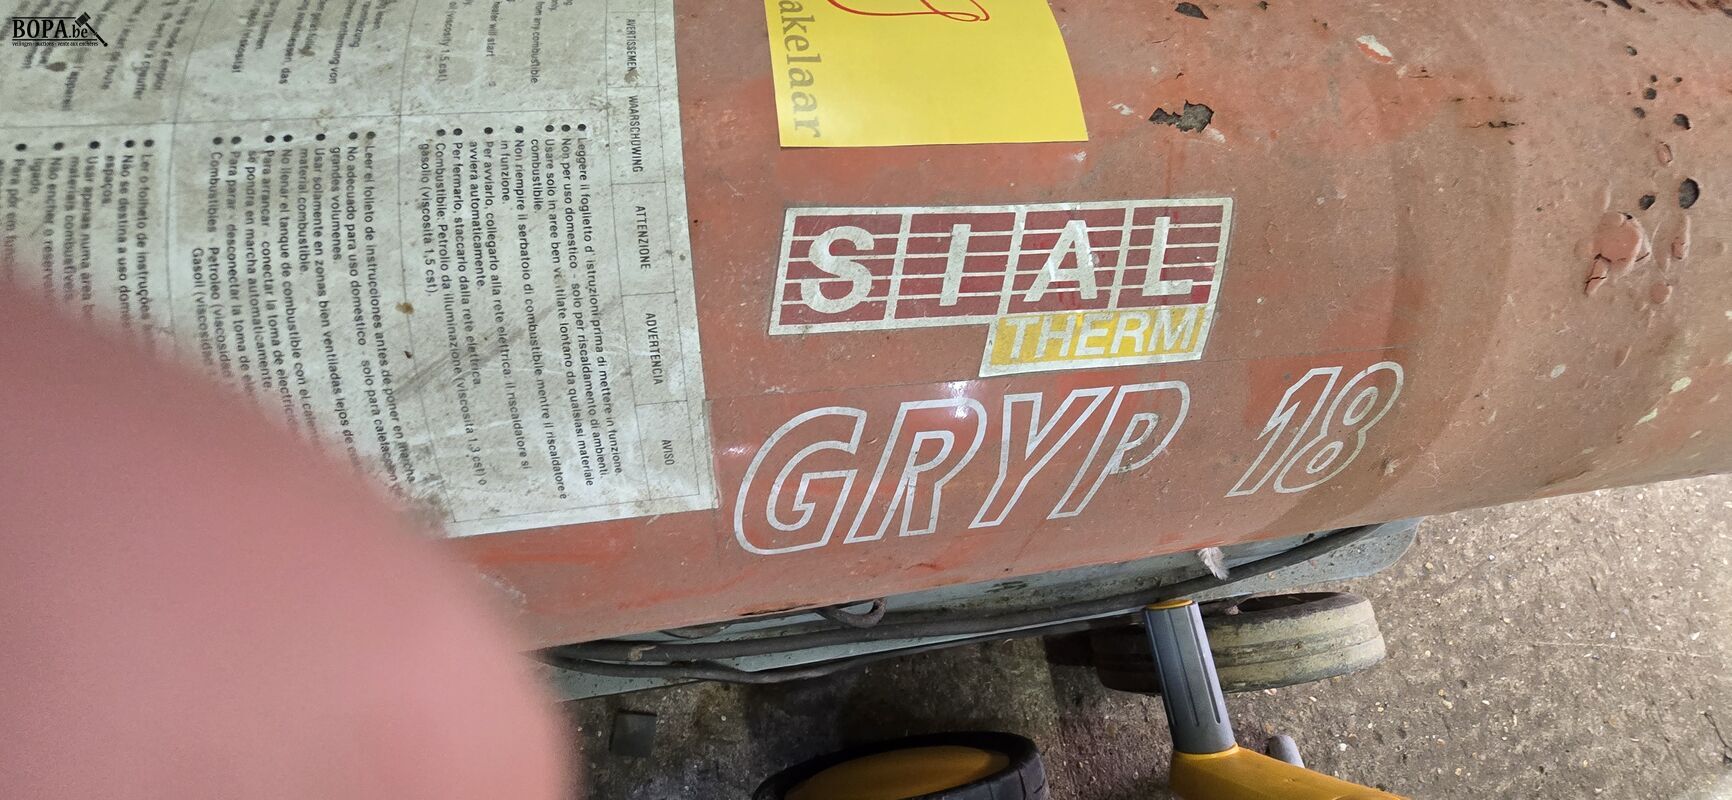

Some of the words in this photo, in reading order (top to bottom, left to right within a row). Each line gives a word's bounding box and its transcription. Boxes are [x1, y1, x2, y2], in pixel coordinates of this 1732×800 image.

[626, 19, 637, 73] AVERTISSEMEN
[452, 143, 463, 159] Per
[483, 142, 495, 157] Per
[500, 141, 510, 149] in
[514, 140, 524, 161] Non
[629, 95, 643, 172] WAARSCHUWING
[418, 144, 432, 183] gasolio
[544, 139, 555, 169] Usare
[559, 163, 570, 180] per
[452, 164, 464, 213] fermarlo,
[500, 153, 511, 204] funzione.
[512, 164, 525, 210] riempire
[530, 139, 544, 213] combustibile.
[546, 173, 556, 196] solo
[563, 184, 572, 203] uso
[547, 200, 558, 209] in
[578, 194, 592, 242] foglietto
[453, 217, 468, 271] staccarlo
[484, 213, 499, 270] collegarlo
[548, 214, 558, 238] aree
[564, 208, 578, 268] domestico
[636, 206, 651, 269] ATTENZIONE
[437, 224, 450, 270] Petrolio
[517, 224, 530, 280] serbatoio
[550, 242, 561, 263] ben
[800, 217, 1193, 314] SIAL
[441, 275, 452, 289] da
[458, 276, 471, 304] dalla
[490, 275, 502, 295] alla
[523, 284, 534, 294] di
[570, 284, 583, 308] solo
[586, 260, 602, 315] istruzioni
[462, 309, 474, 332] rete
[493, 300, 504, 322] rete
[572, 312, 585, 331] per
[443, 294, 462, 374] illuminazione
[524, 299, 544, 375] combustibile
[559, 323, 573, 367] lontano
[589, 320, 603, 352] prima
[646, 313, 663, 385] ADVERTENCIA
[1004, 305, 1197, 359] THERM
[565, 371, 576, 384] da
[577, 335, 596, 415] riscaldamento
[596, 357, 607, 366] di
[536, 380, 551, 418] mentre
[598, 371, 612, 413] mettere
[506, 392, 527, 457] riscaldatore
[566, 389, 586, 437] qualsiasi
[589, 419, 601, 429] di
[605, 418, 614, 426] in
[520, 461, 532, 469] si
[545, 432, 565, 490] riscaldatore
[577, 441, 594, 486] materiale
[592, 432, 608, 478] ambienti.
[662, 440, 675, 465] AVISO
[735, 380, 1191, 554] GRYP
[1224, 361, 1403, 498] 18
